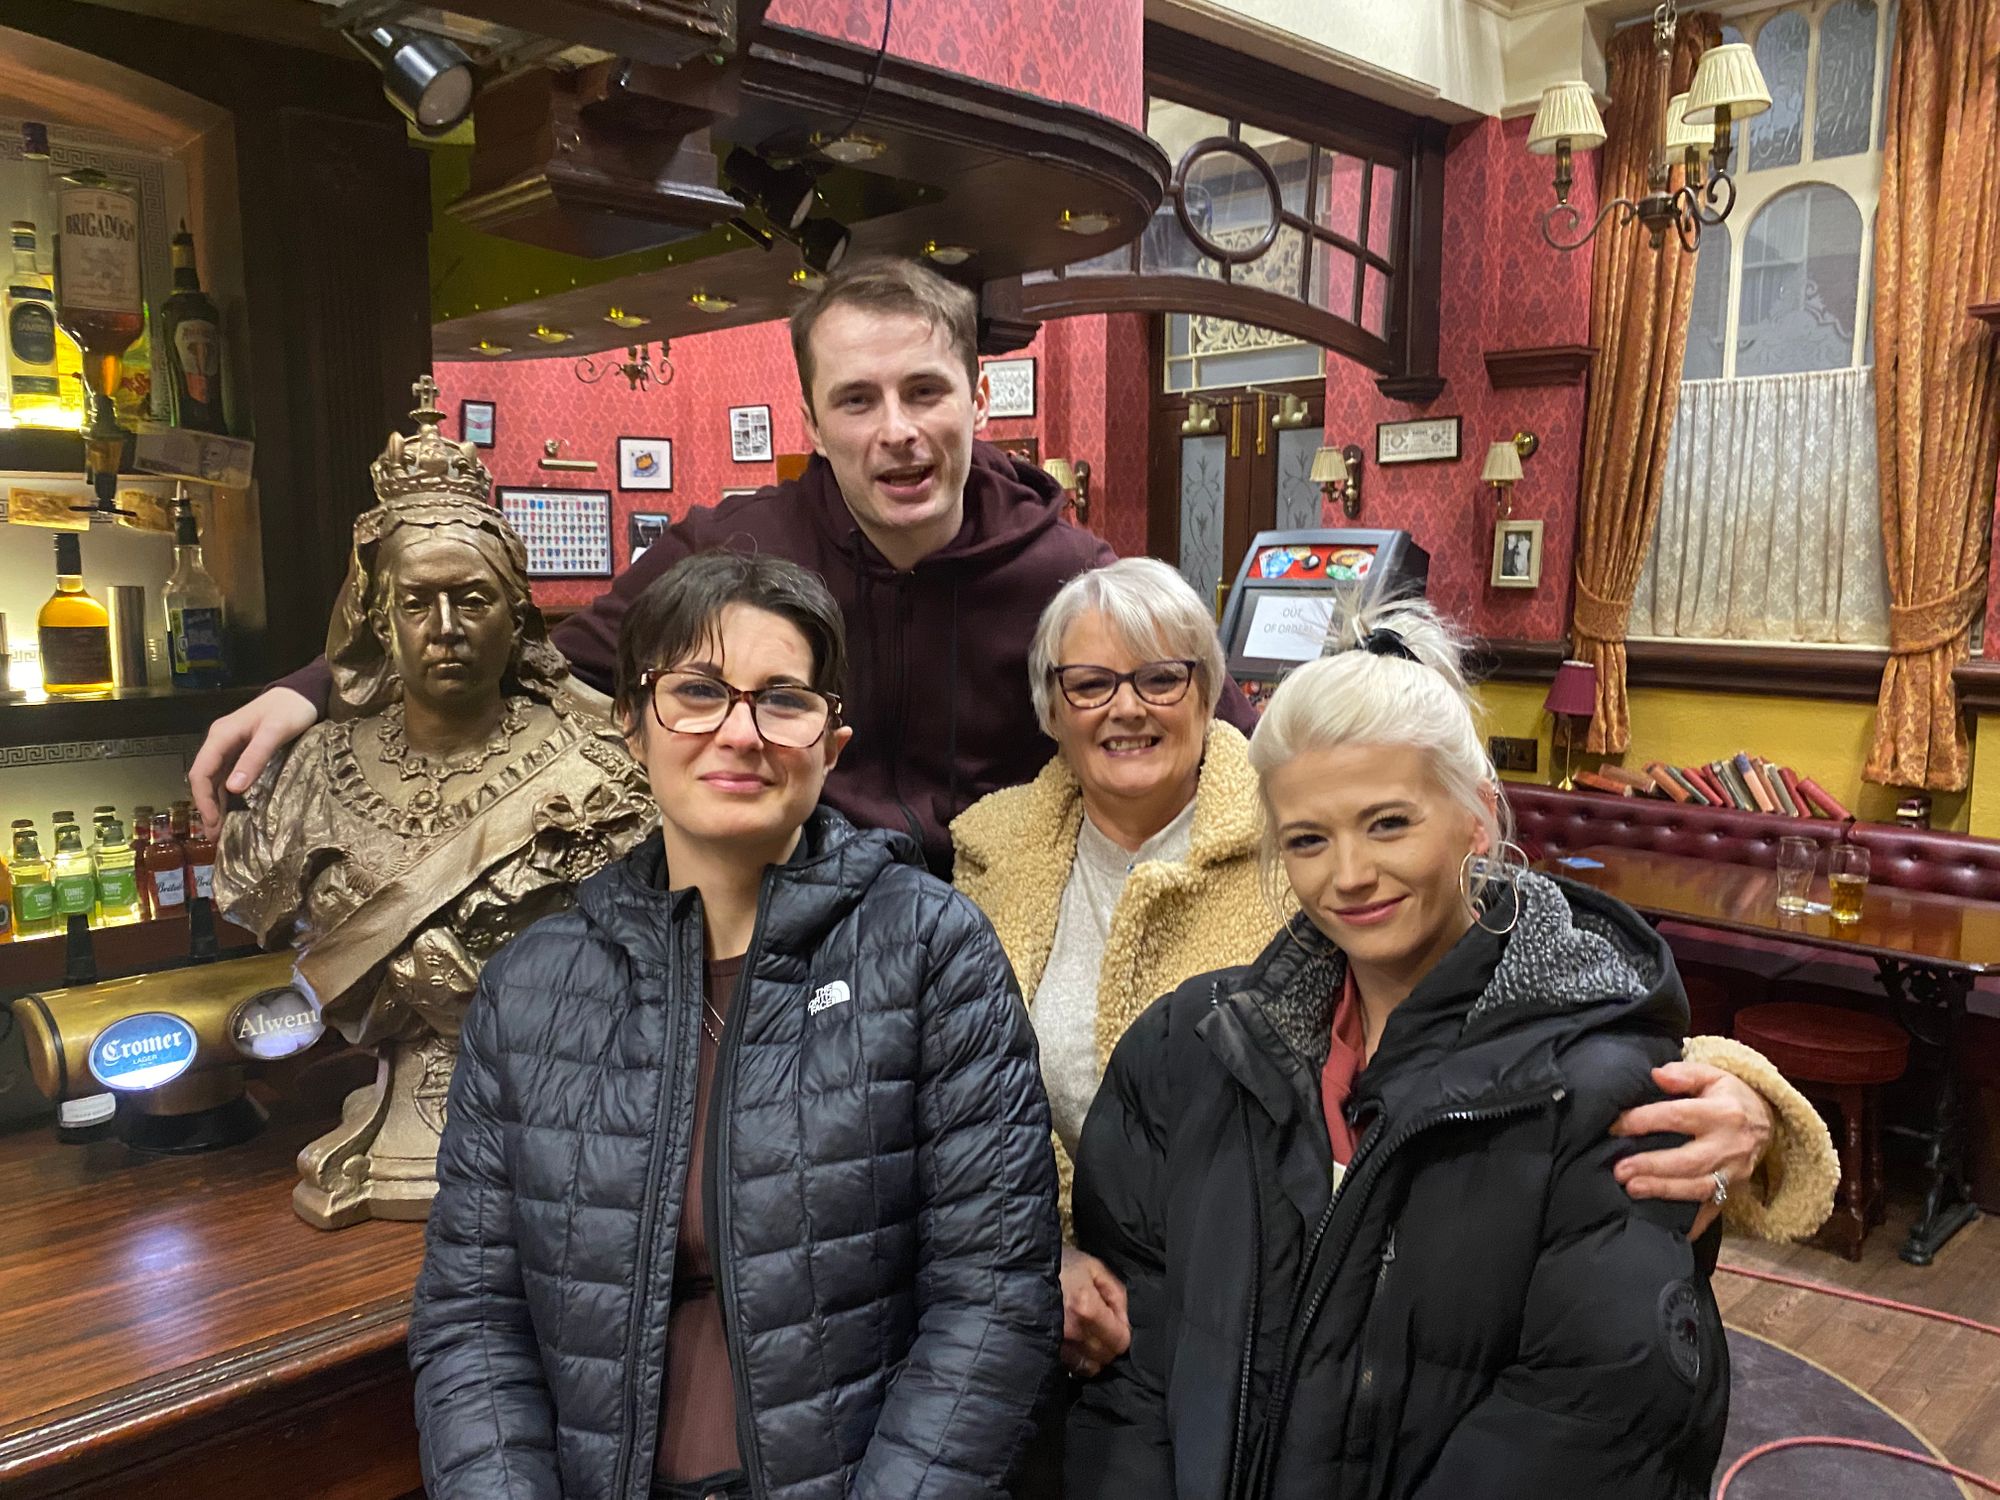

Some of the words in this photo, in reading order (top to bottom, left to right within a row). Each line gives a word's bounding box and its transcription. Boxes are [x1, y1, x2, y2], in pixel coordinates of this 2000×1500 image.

[1283, 607, 1304, 618] OUT
[1263, 623, 1277, 634] OF
[101, 1031, 182, 1066] Cromer
